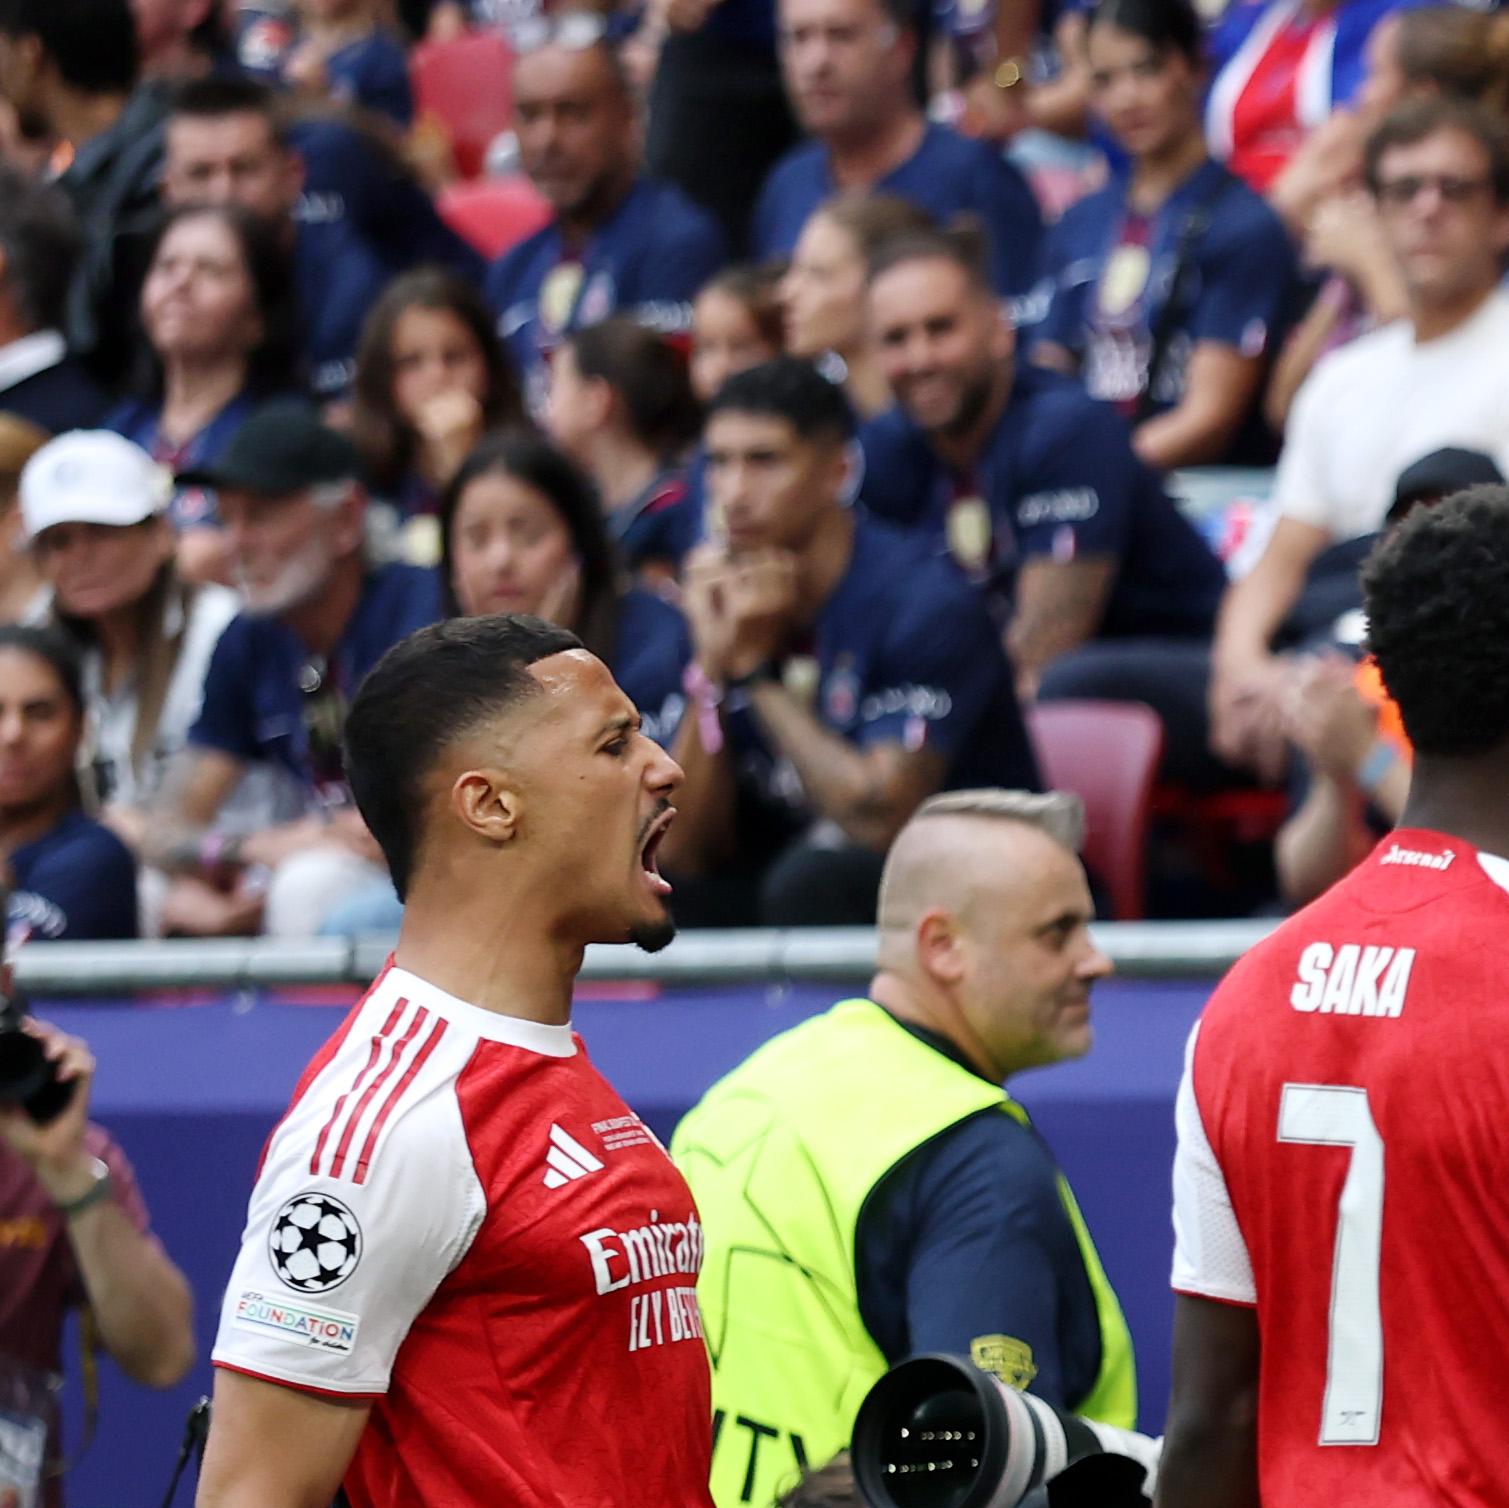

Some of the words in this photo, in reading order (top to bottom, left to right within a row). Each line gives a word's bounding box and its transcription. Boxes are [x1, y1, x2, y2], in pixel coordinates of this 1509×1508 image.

[1380, 845, 1456, 871] Arsenal
[1290, 942, 1416, 1018] SAKA
[579, 1209, 704, 1296] Emirat
[1277, 1082, 1386, 1446] 7
[629, 1290, 664, 1352] FLY
